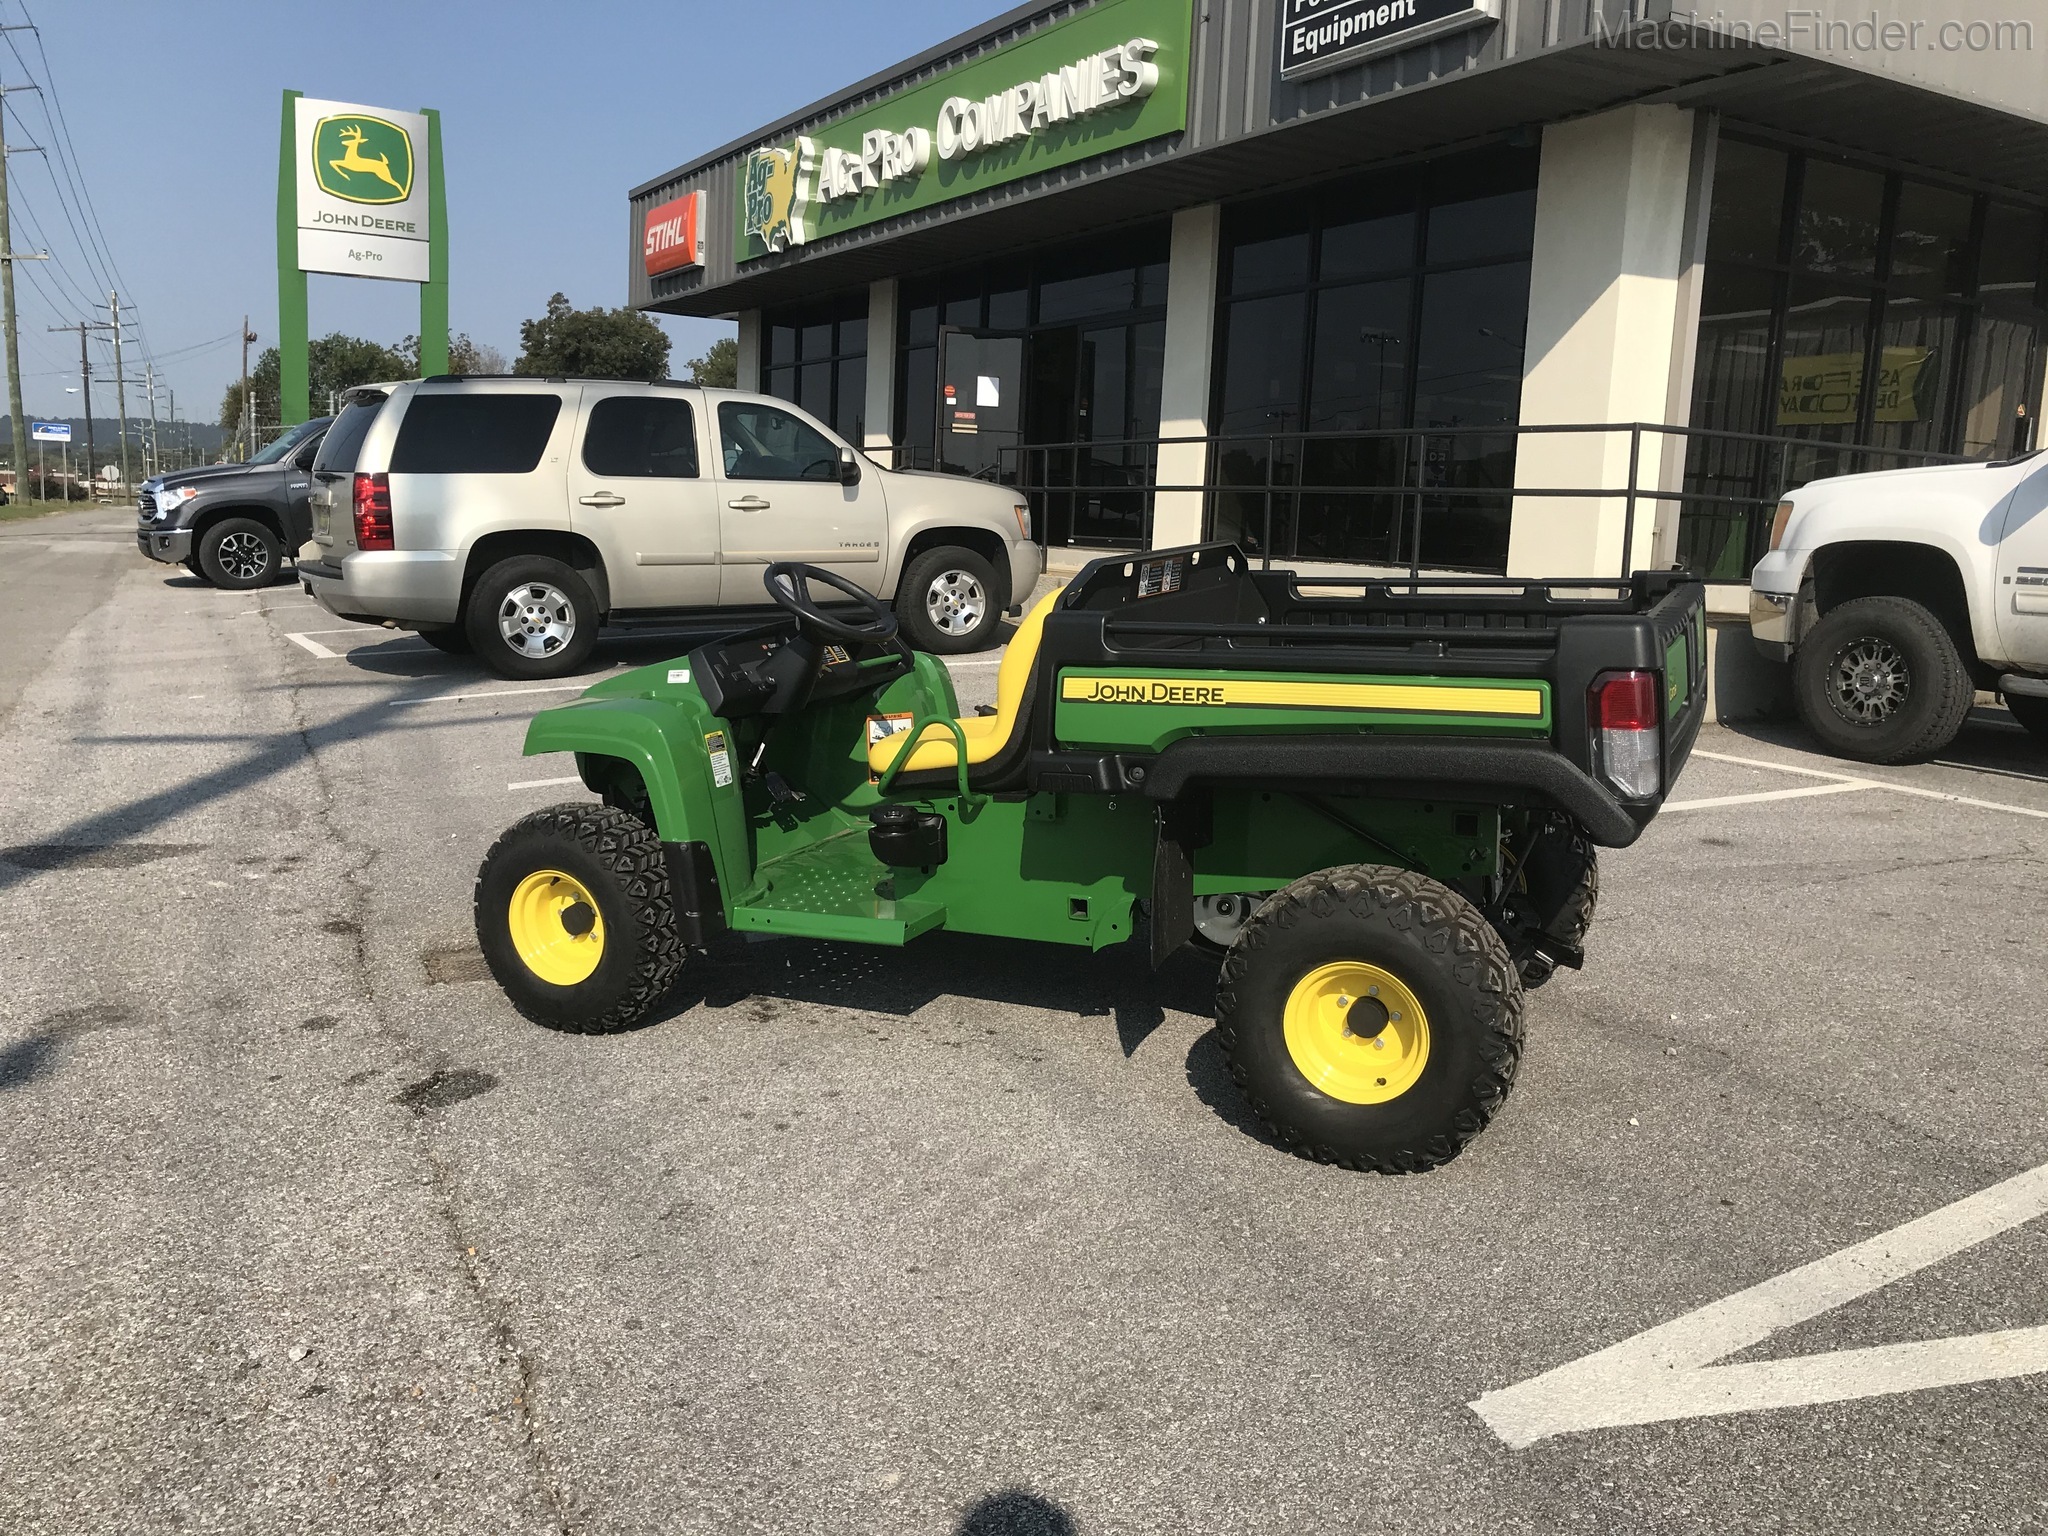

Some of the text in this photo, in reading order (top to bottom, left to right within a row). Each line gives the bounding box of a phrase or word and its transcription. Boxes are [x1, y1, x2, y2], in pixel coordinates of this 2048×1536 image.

[1292, 0, 1417, 55] Equipment
[816, 37, 1159, 204] AG-PRO COMPANIES
[312, 210, 416, 233] JOHN DEERE
[746, 191, 774, 233] Pro
[347, 248, 383, 262] Ag-Pro
[645, 214, 685, 256] STIHL
[1087, 681, 1225, 702] JOHN DEERE
